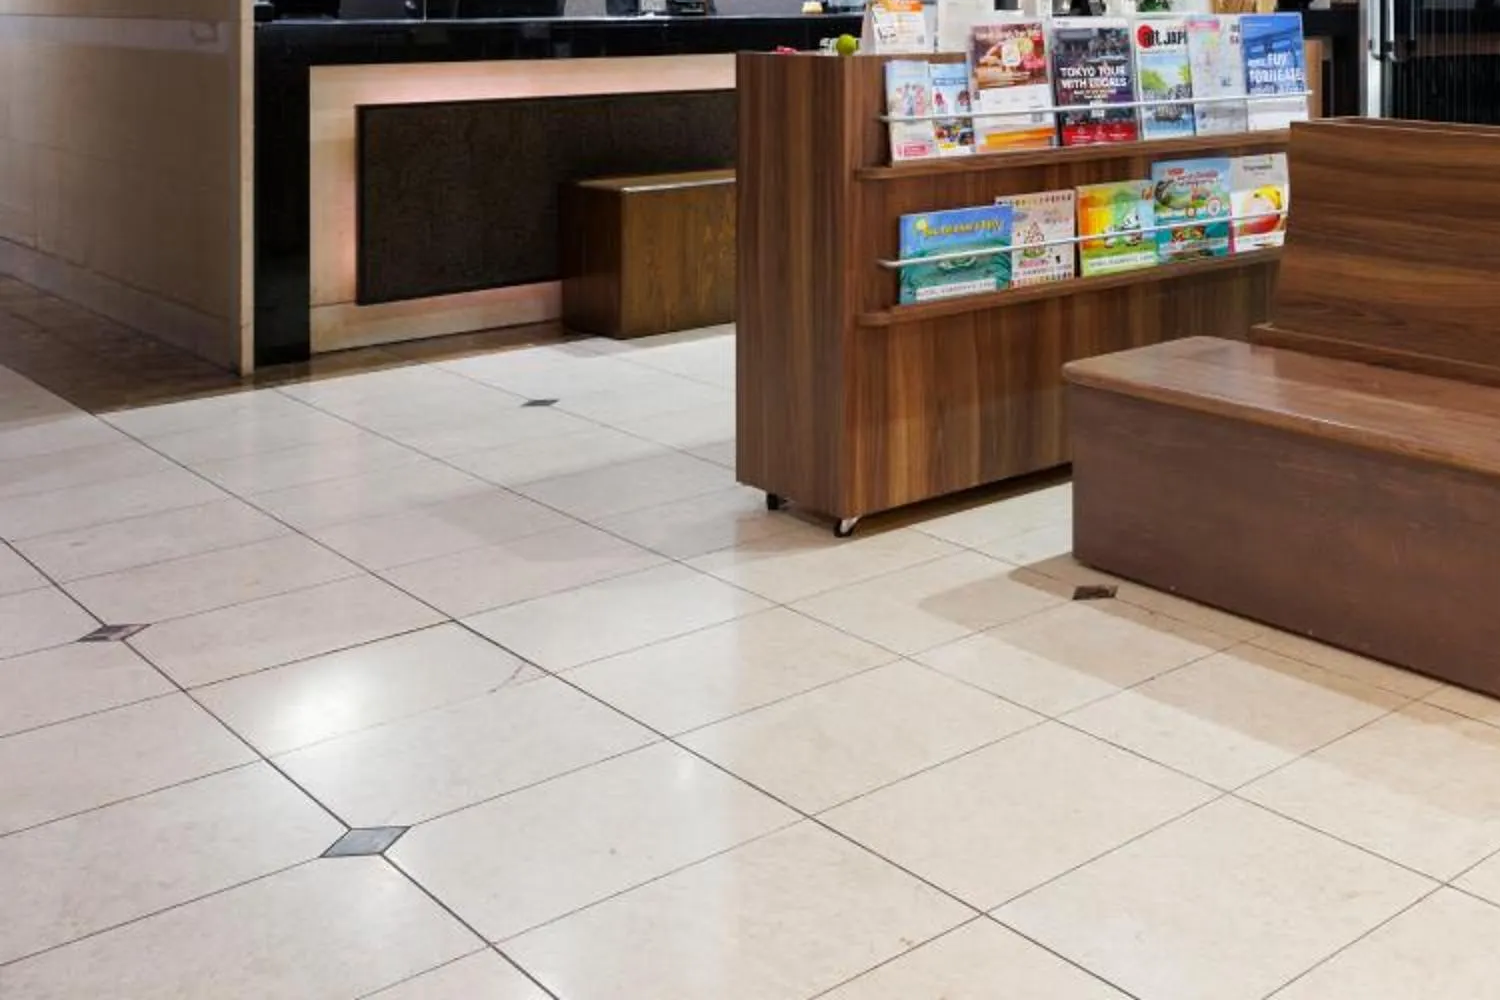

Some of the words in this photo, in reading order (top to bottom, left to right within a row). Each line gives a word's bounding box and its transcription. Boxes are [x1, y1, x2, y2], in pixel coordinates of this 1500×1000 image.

[1060, 66, 1096, 78] TOKYO
[1098, 64, 1126, 77] TOUR
[1061, 79, 1087, 89] WITH
